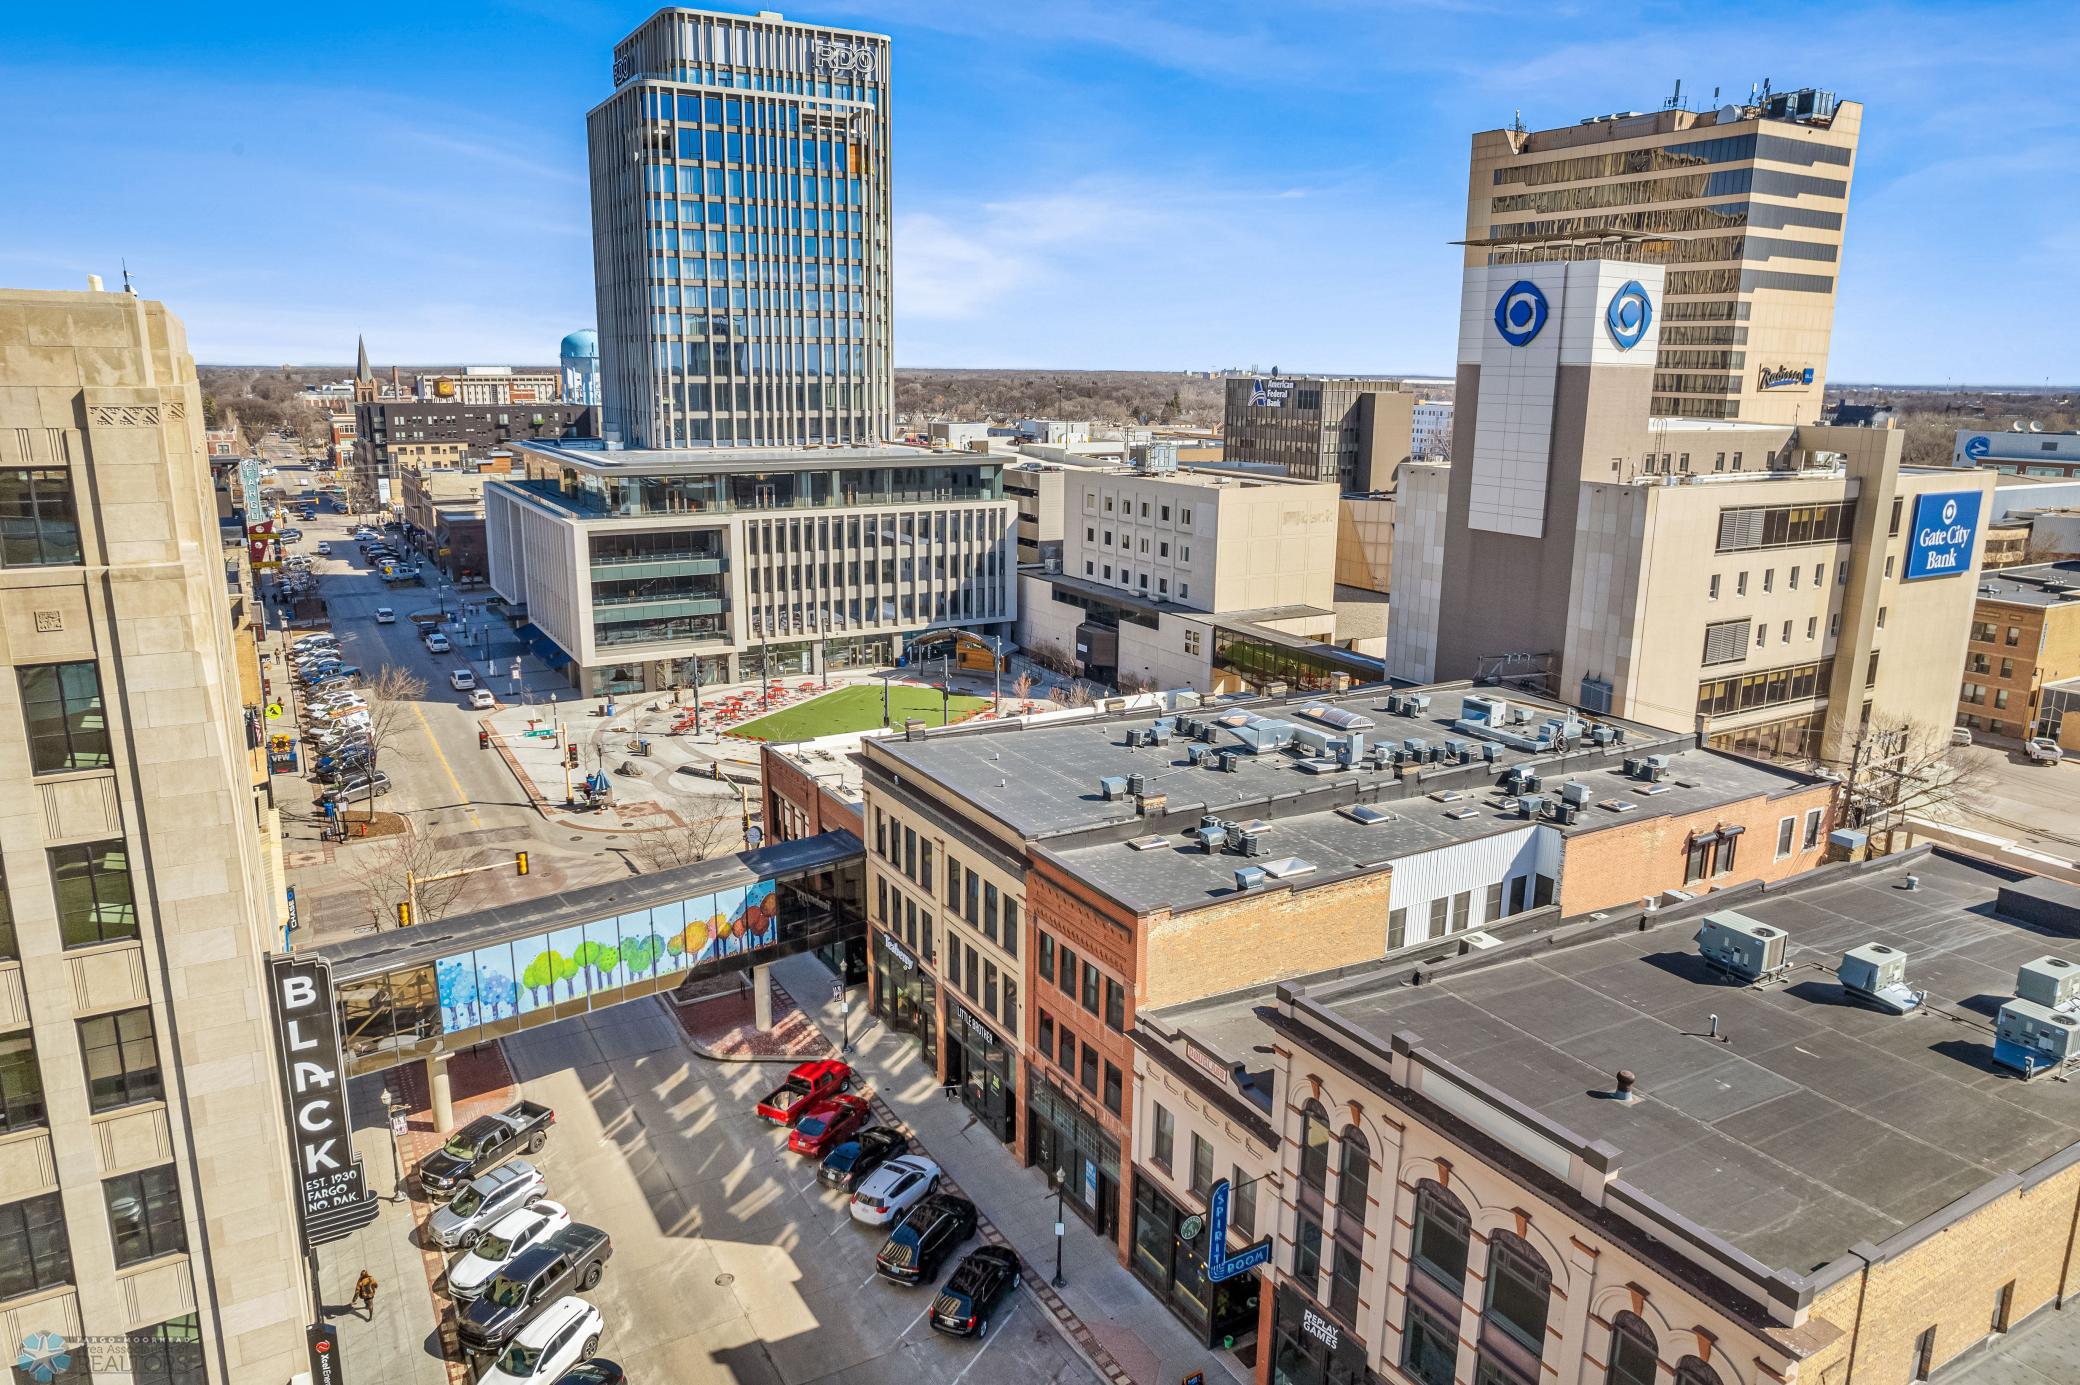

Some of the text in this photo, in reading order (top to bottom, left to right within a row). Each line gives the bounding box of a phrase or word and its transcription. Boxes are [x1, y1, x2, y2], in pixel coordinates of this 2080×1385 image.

[815, 44, 876, 72] RDO
[1267, 390, 1288, 398] Federal
[1268, 380, 1294, 389] American
[1266, 399, 1281, 407] Bank
[246, 469, 259, 520] FARGO
[1920, 525, 1971, 548] Gate City
[1925, 547, 1957, 570] Bank
[271, 753, 290, 762] VFW
[288, 900, 298, 928] CHASE
[884, 933, 914, 970] Teaberry
[957, 1005, 993, 1045] LITTLE BROTHER
[283, 976, 335, 1174] BLACK
[306, 1170, 357, 1191] EST. 1930
[308, 1184, 347, 1201] FARGO
[309, 1191, 360, 1212] NO. DAK.
[1214, 1195, 1225, 1265] SPIRIT
[1227, 1251, 1264, 1274] ROOM
[1304, 1309, 1338, 1337] REPLAY
[1303, 1321, 1338, 1350] GAMES
[320, 1353, 331, 1370] Xcel
